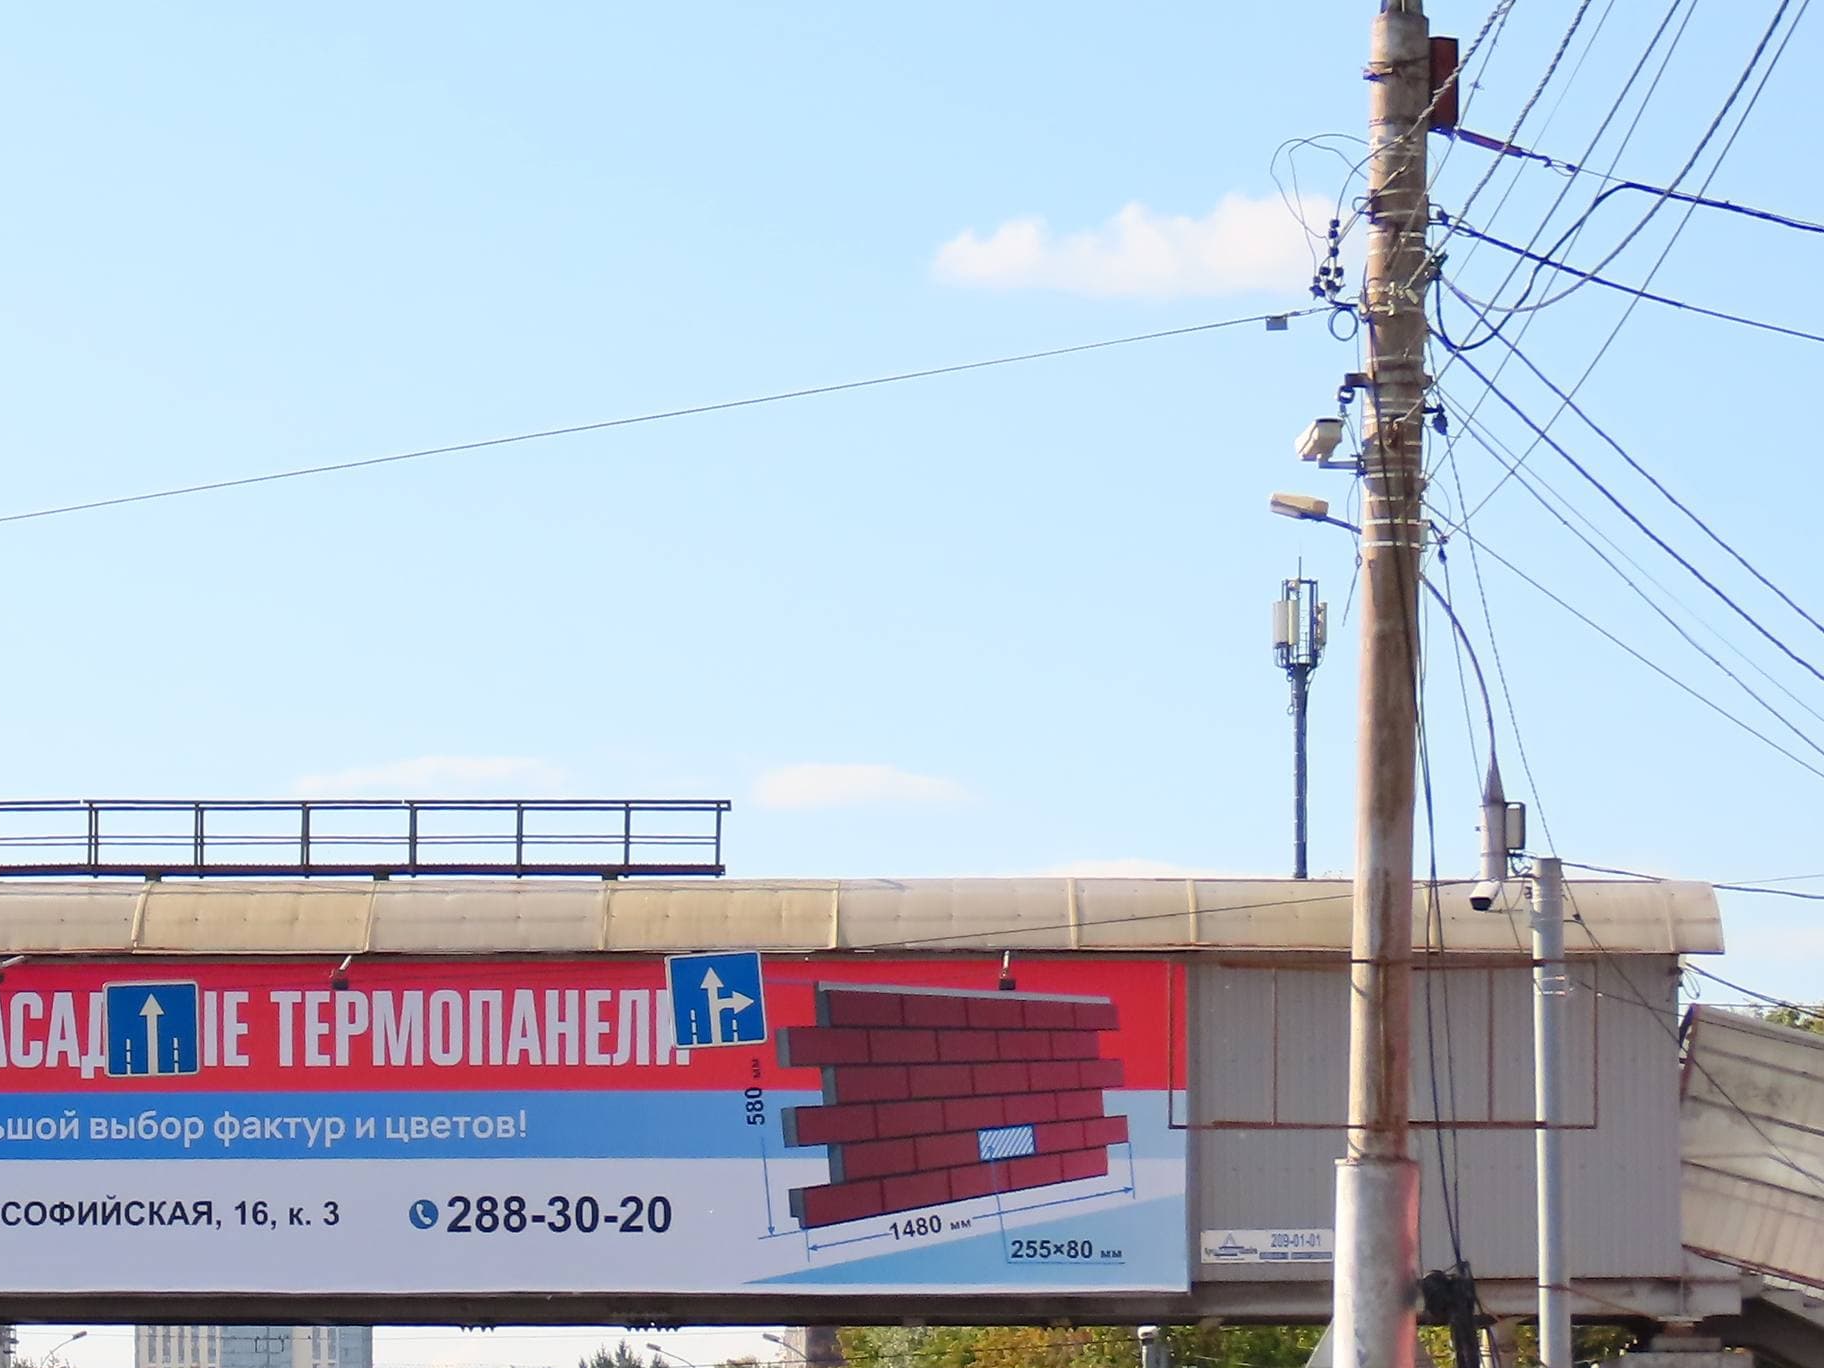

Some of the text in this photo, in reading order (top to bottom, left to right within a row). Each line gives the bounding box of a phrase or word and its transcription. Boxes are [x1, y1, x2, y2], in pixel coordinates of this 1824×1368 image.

[744, 1087, 765, 1125] 580
[90, 1110, 205, 1147] выбор
[214, 1110, 345, 1147] фактур
[356, 1118, 375, 1138] и
[386, 1110, 526, 1143] цветов!
[1, 1195, 222, 1230] СОФИЙСКАЯ,
[234, 1201, 276, 1231] 16,
[289, 1208, 311, 1226] к.
[324, 1201, 340, 1226] 3
[447, 1195, 672, 1233] 288-30-20
[889, 1215, 942, 1240] 1480
